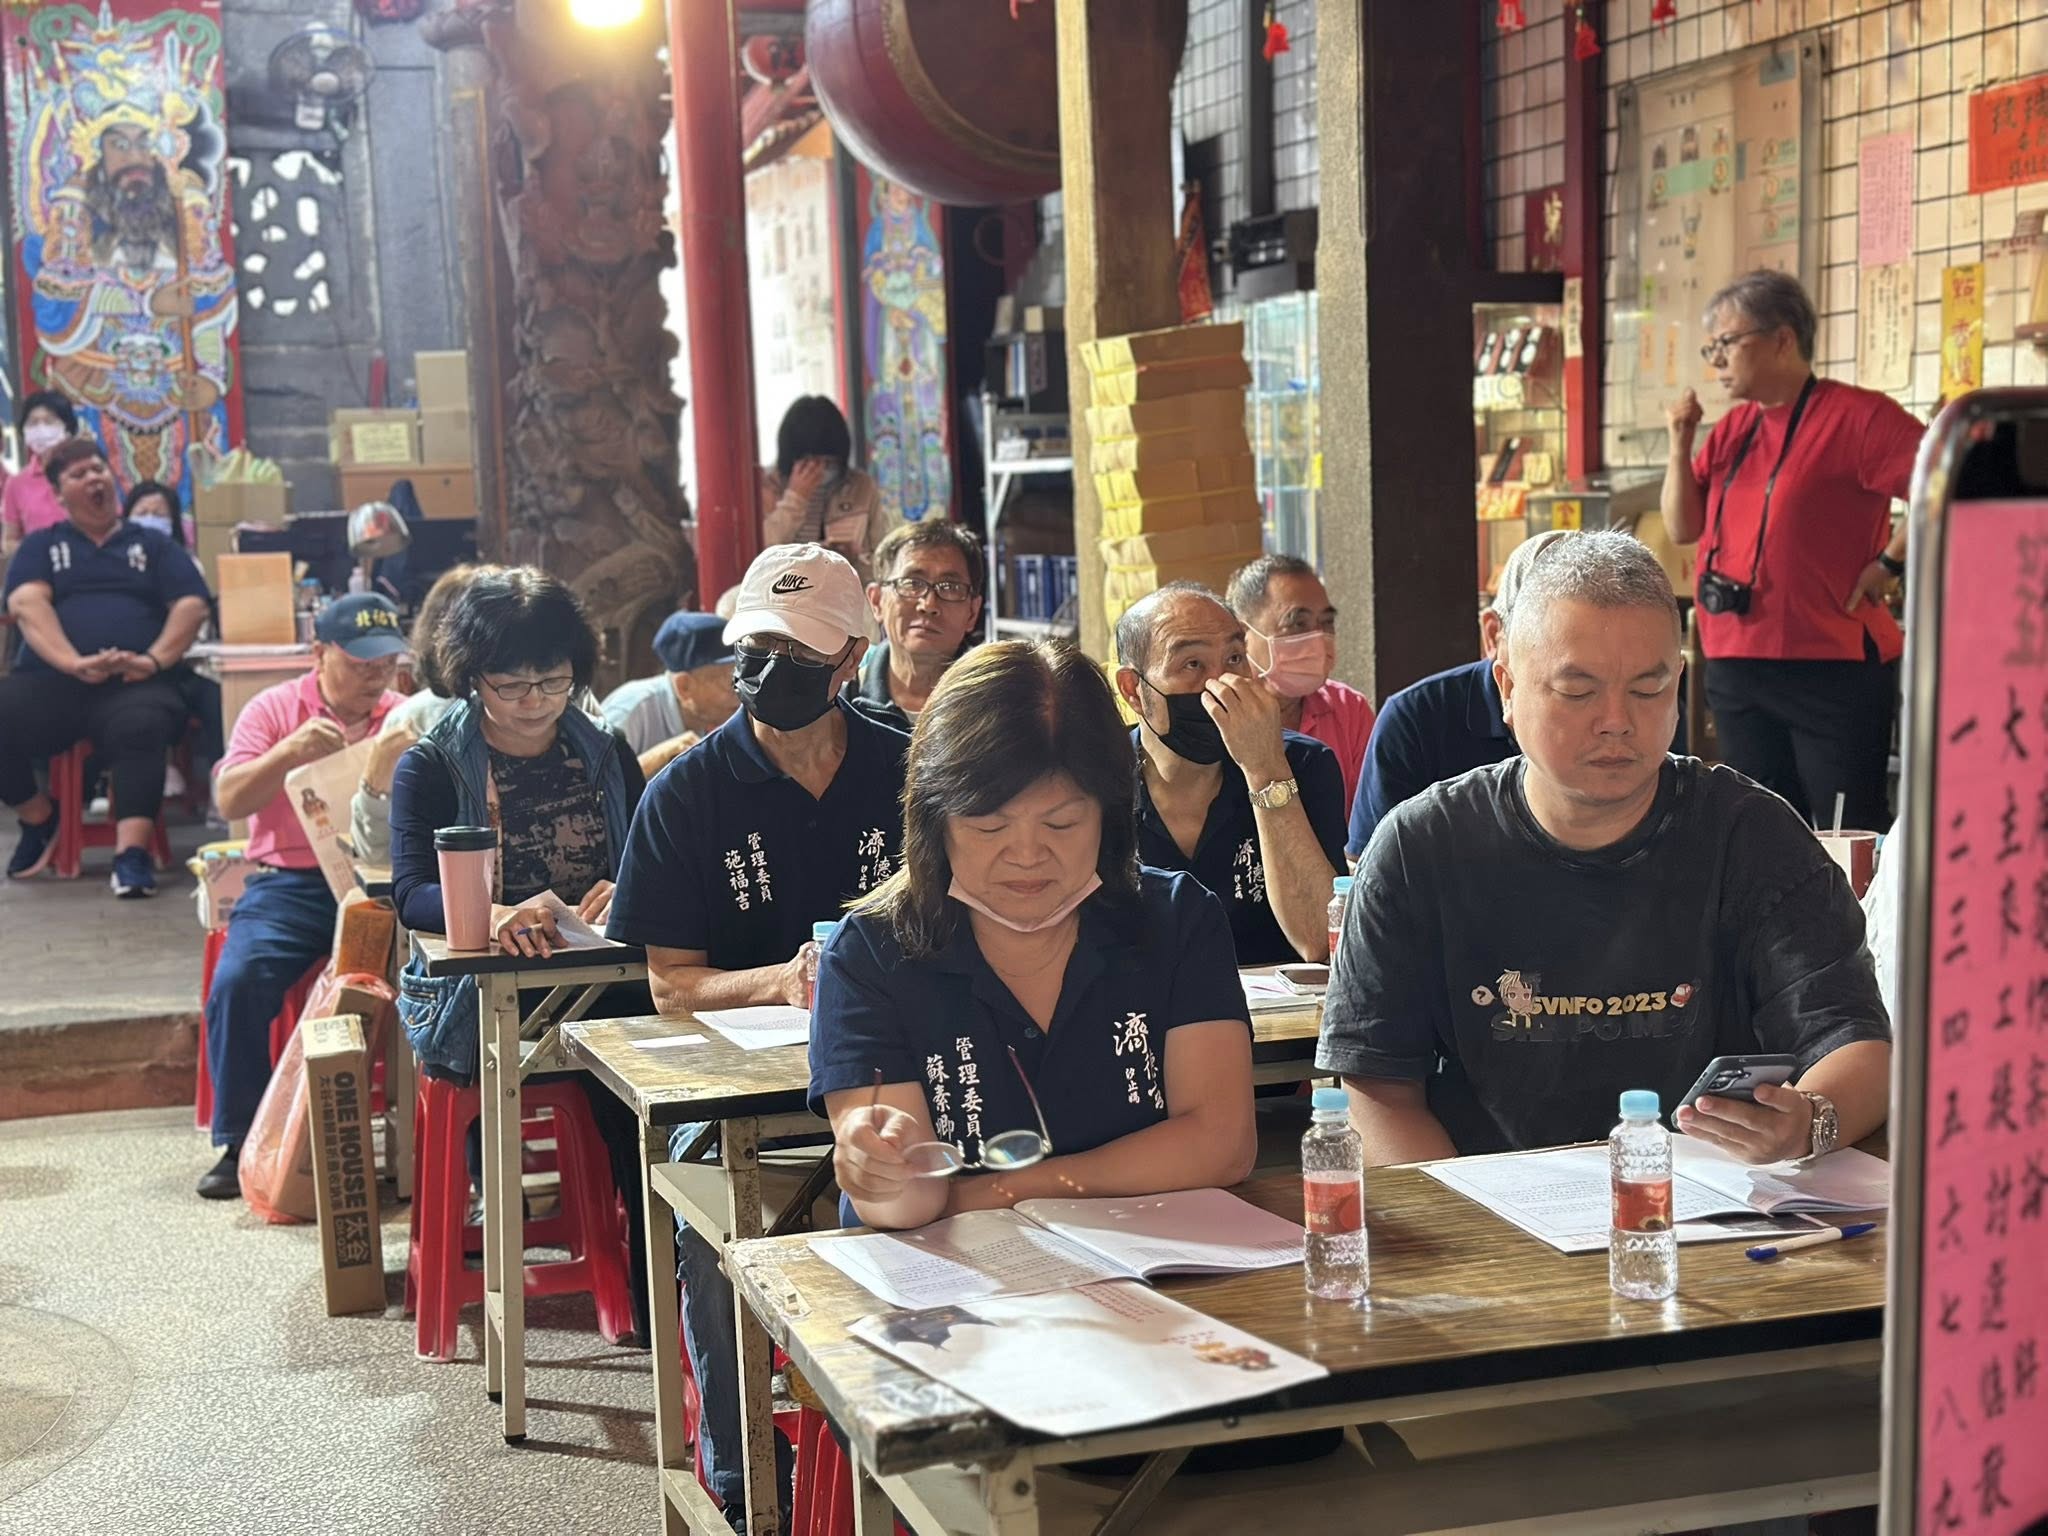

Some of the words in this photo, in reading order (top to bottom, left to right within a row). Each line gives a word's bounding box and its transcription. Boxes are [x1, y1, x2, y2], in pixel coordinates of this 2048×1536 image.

[778, 573, 808, 588] NIKE
[724, 849, 750, 911] 施福吉
[747, 831, 773, 903] 管理委員
[1943, 897, 1968, 963] 三
[1606, 991, 1667, 1016] 2023
[334, 1072, 359, 1122] ONE
[926, 1053, 954, 1141] 蘇素卿
[956, 1036, 983, 1138] 管理委員
[339, 1125, 367, 1208] HOUSE
[345, 1216, 369, 1261] 太谷
